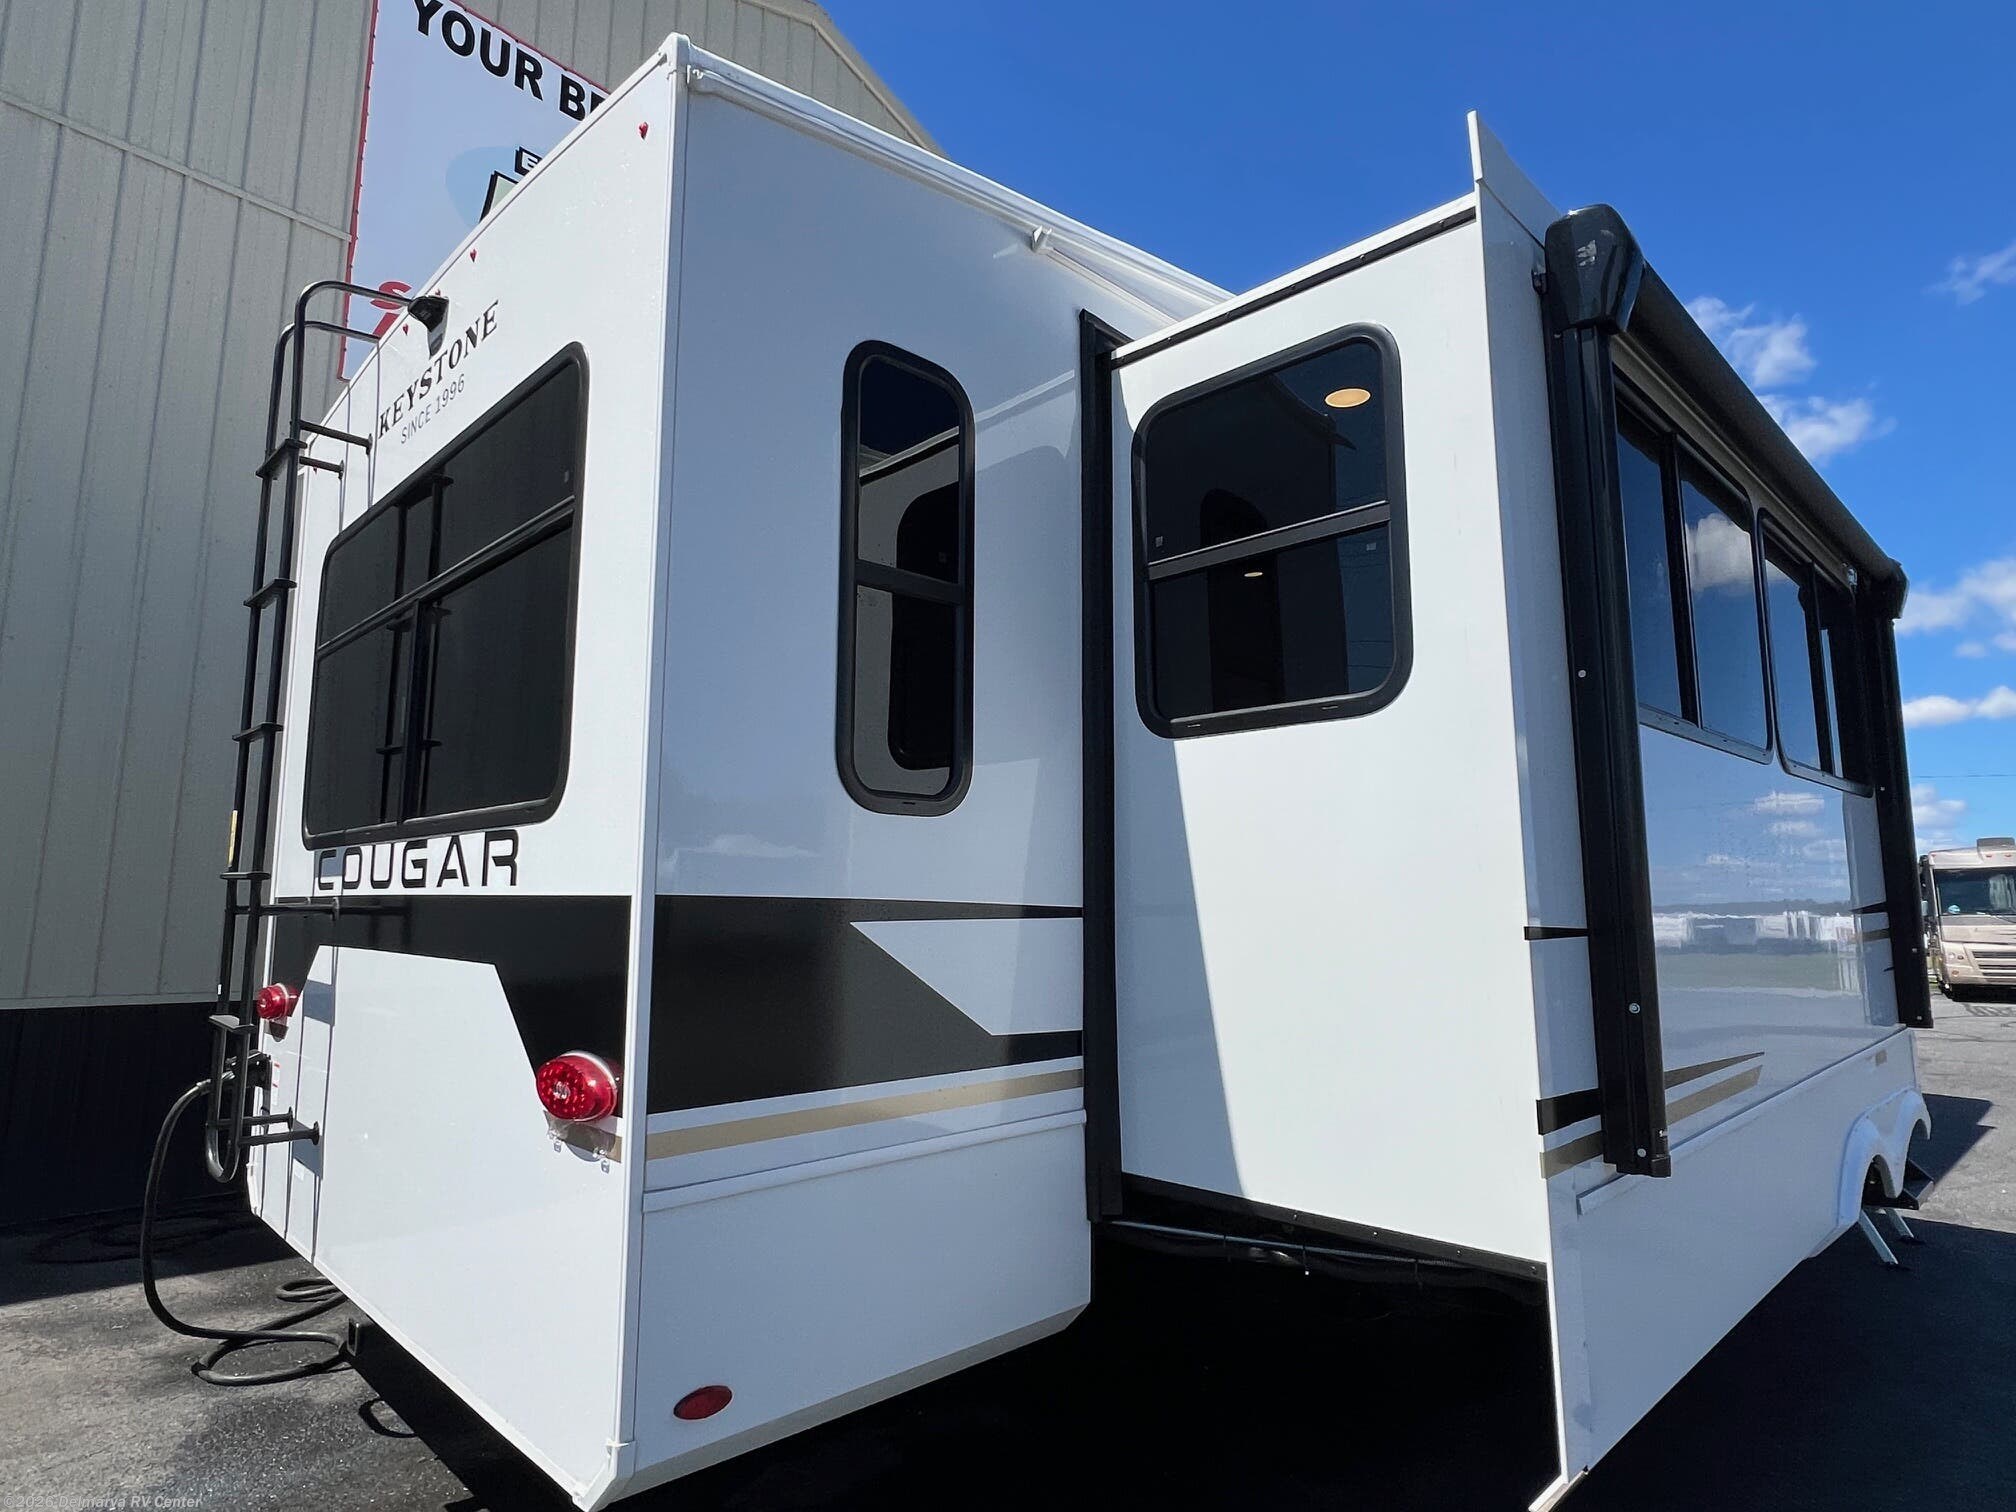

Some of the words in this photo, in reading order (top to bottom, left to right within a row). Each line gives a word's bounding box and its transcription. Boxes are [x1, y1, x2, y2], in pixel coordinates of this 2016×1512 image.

[412, 0, 544, 101] YOUR
[378, 300, 499, 439] KEYSTONE
[400, 403, 432, 444] SINCE
[435, 373, 465, 414] 1996
[317, 829, 518, 890] COUGAR
